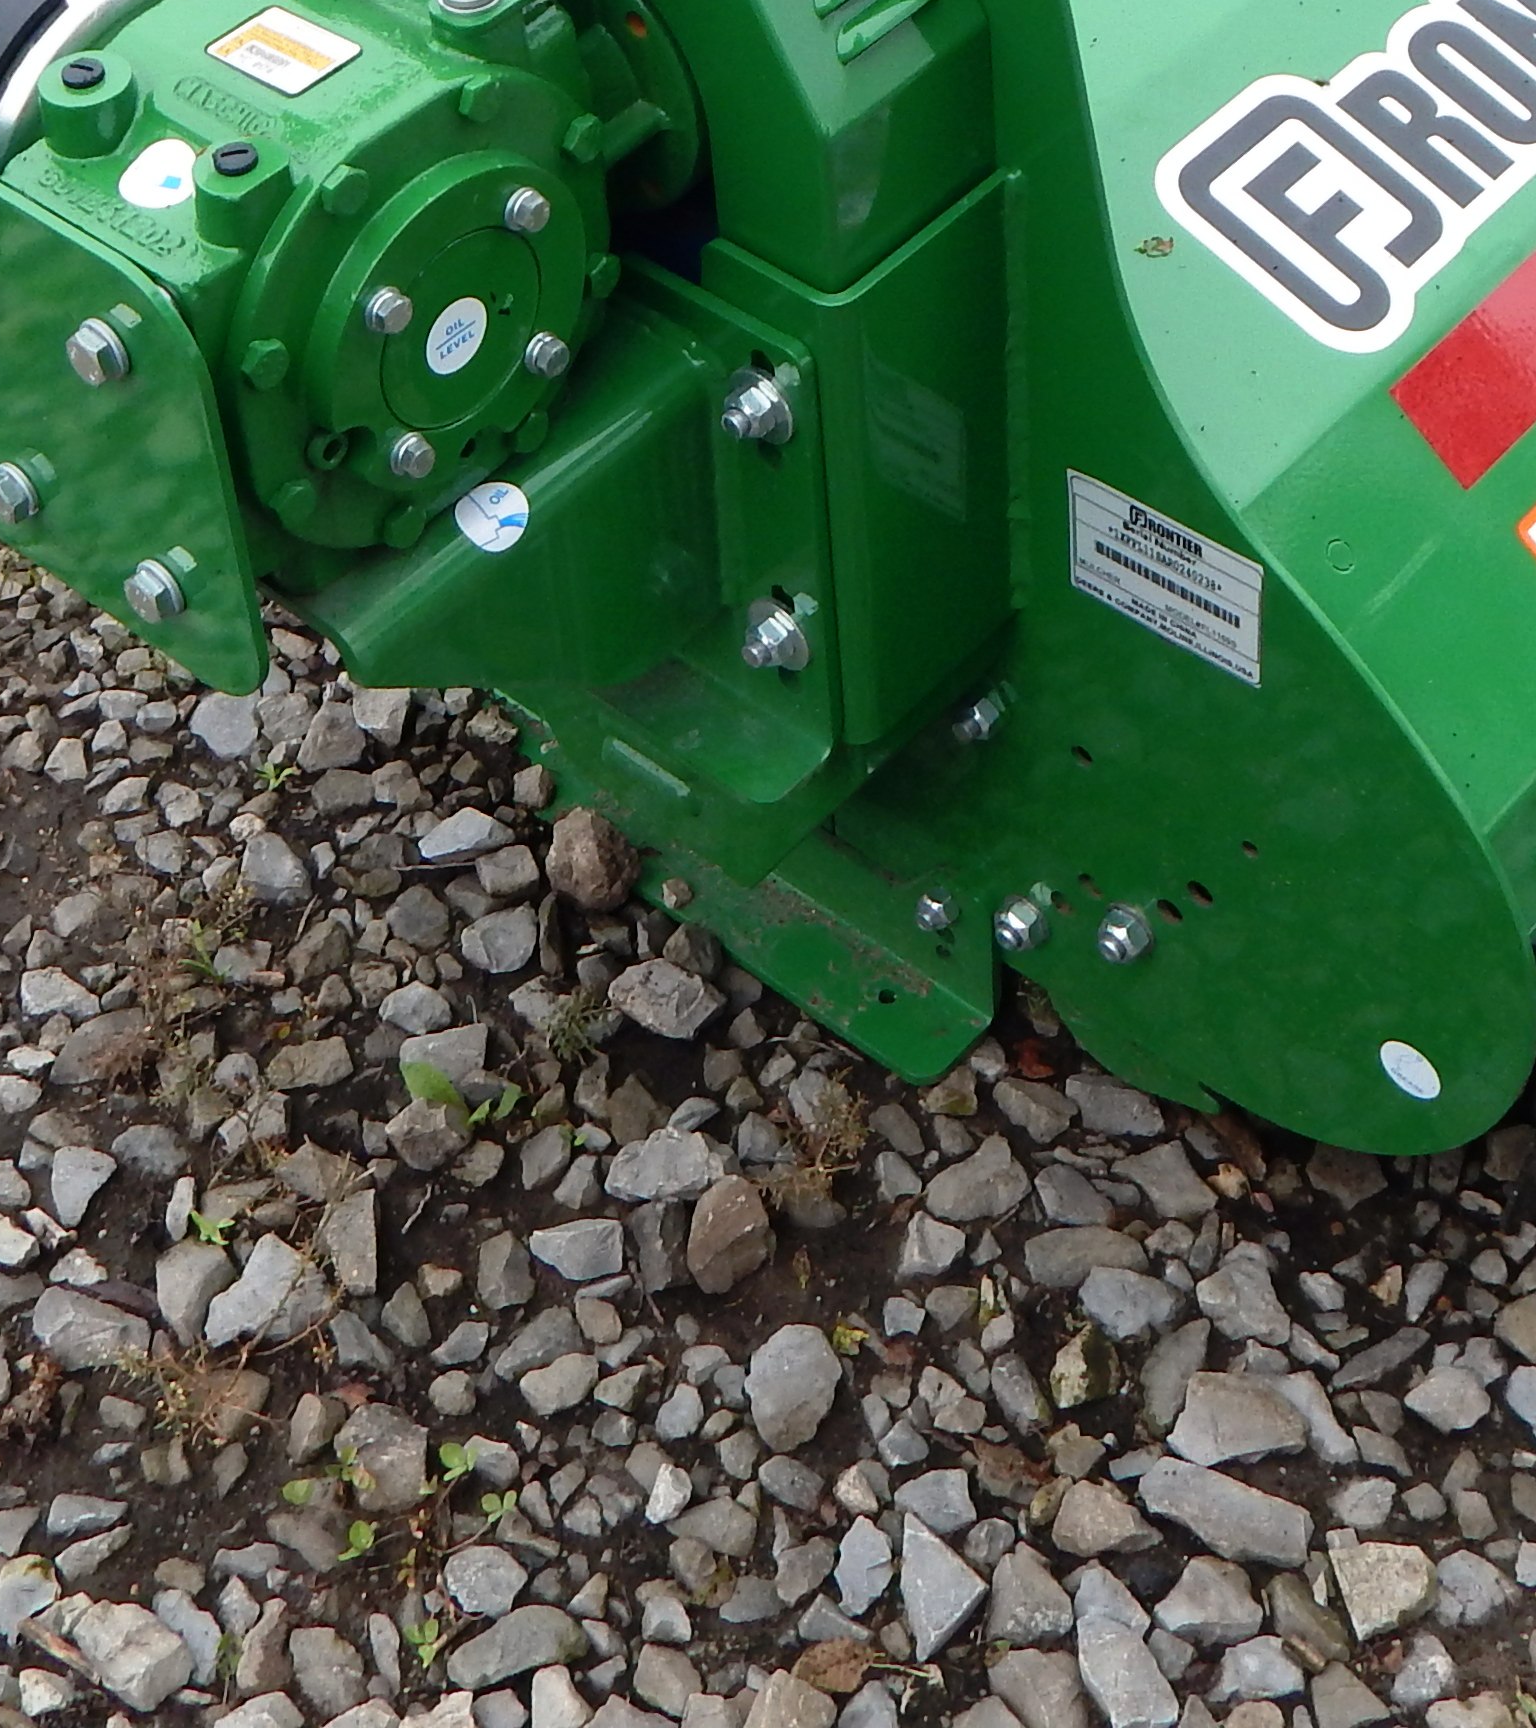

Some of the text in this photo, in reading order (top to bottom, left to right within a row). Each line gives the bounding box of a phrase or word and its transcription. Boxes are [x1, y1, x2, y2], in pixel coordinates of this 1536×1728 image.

[445, 318, 465, 336] OIL
[439, 330, 476, 360] LEVEL
[488, 487, 511, 505] OIL
[1129, 503, 1202, 558] FRONTIER
